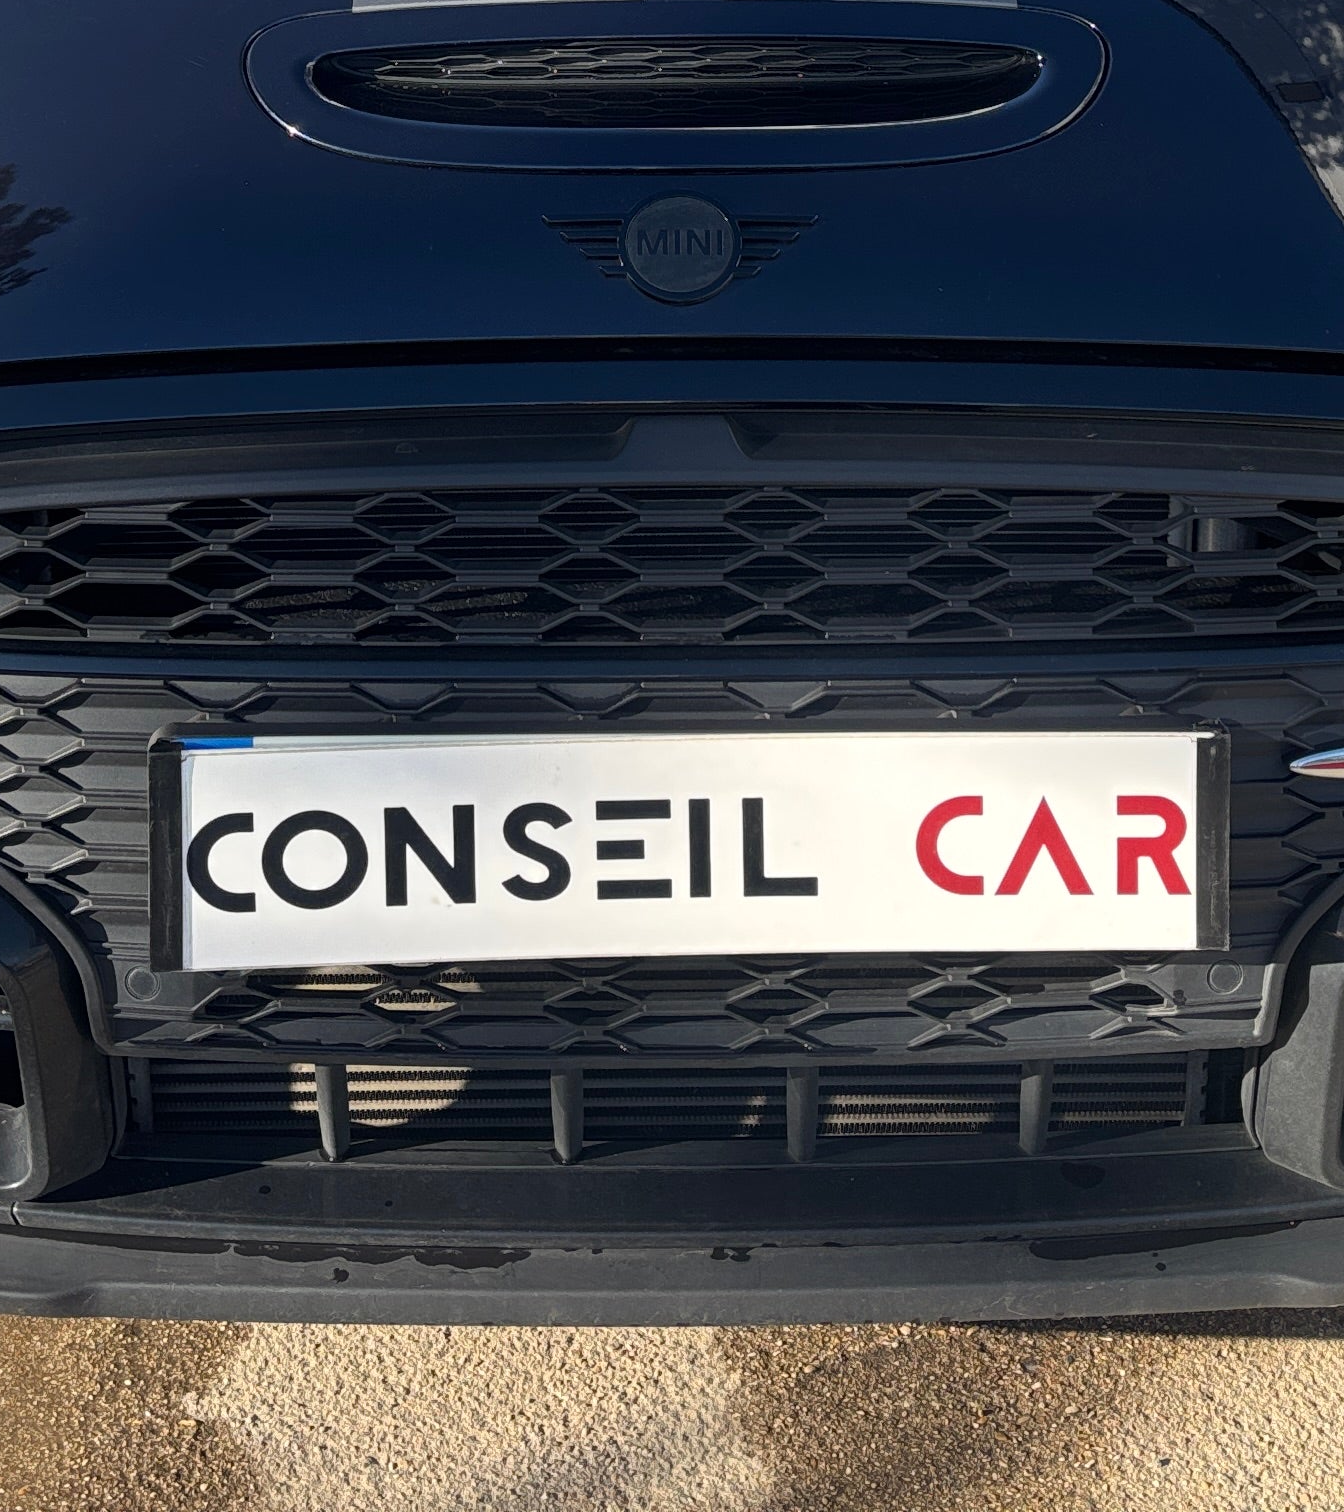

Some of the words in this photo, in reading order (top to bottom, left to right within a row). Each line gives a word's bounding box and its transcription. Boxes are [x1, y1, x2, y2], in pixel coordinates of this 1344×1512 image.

[637, 228, 724, 257] MINI
[187, 798, 817, 913] CONSEIL
[916, 795, 1190, 895] CAR
